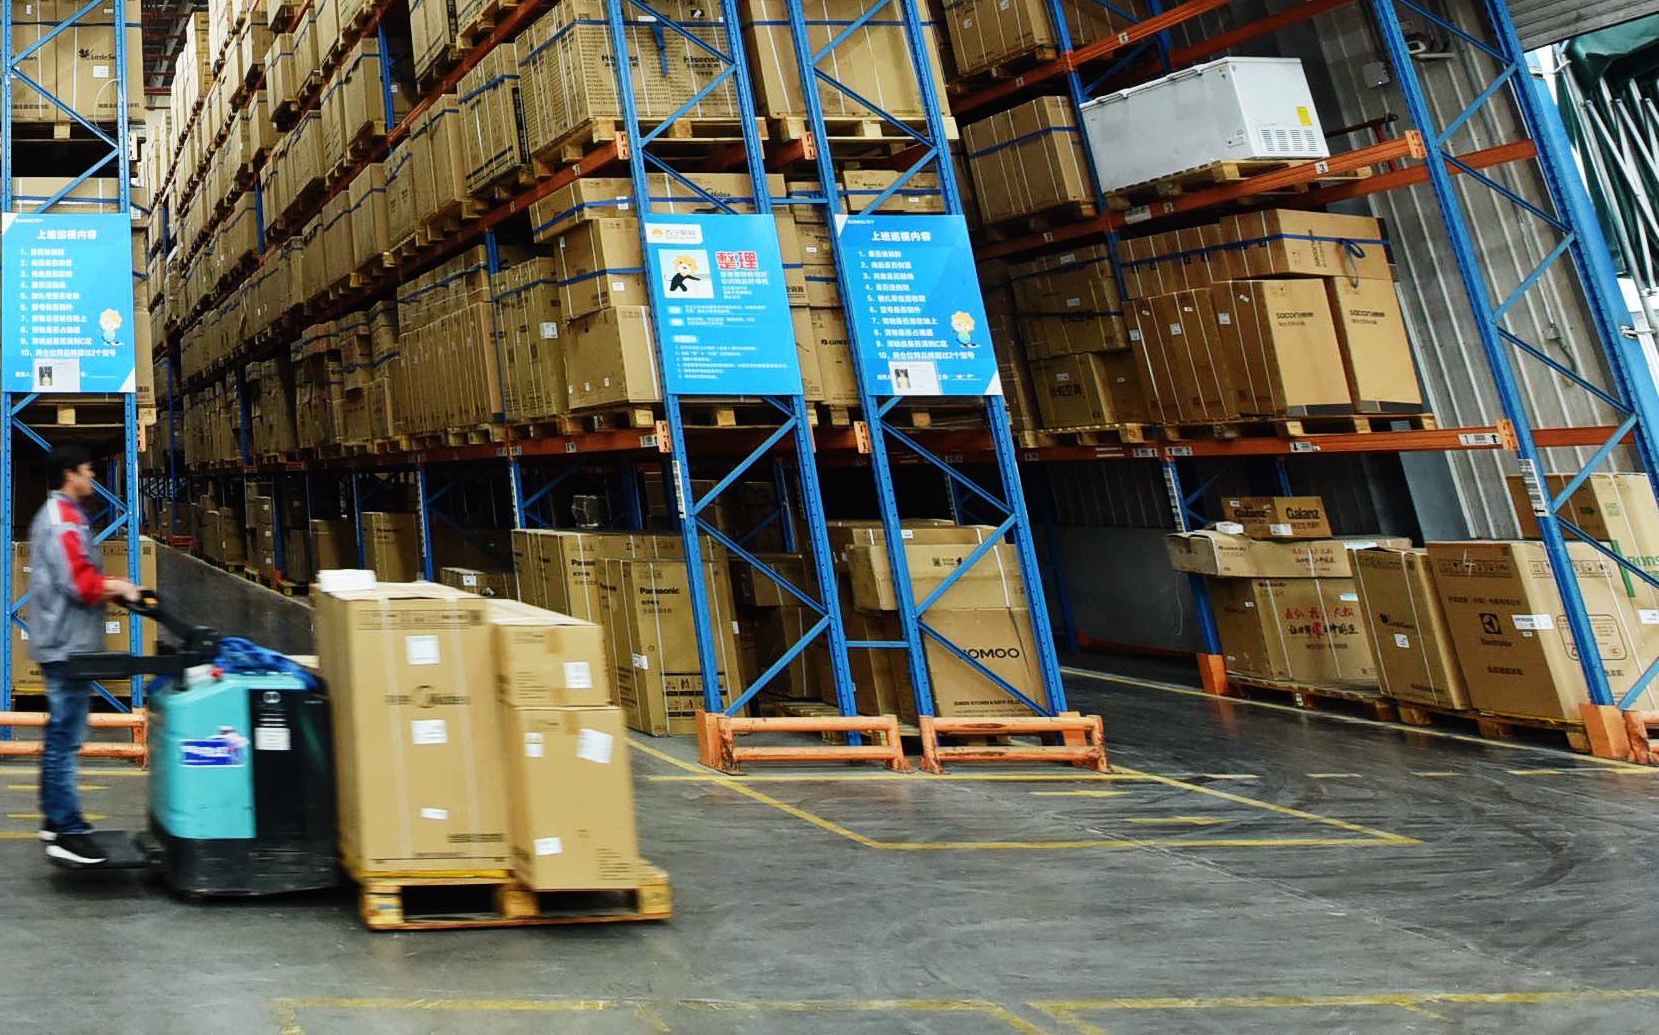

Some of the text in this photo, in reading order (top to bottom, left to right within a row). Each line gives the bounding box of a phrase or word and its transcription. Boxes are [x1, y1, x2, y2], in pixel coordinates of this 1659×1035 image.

[716, 252, 758, 270] 整理
[1286, 507, 1320, 520] Galanz
[640, 587, 680, 595] Panasonic
